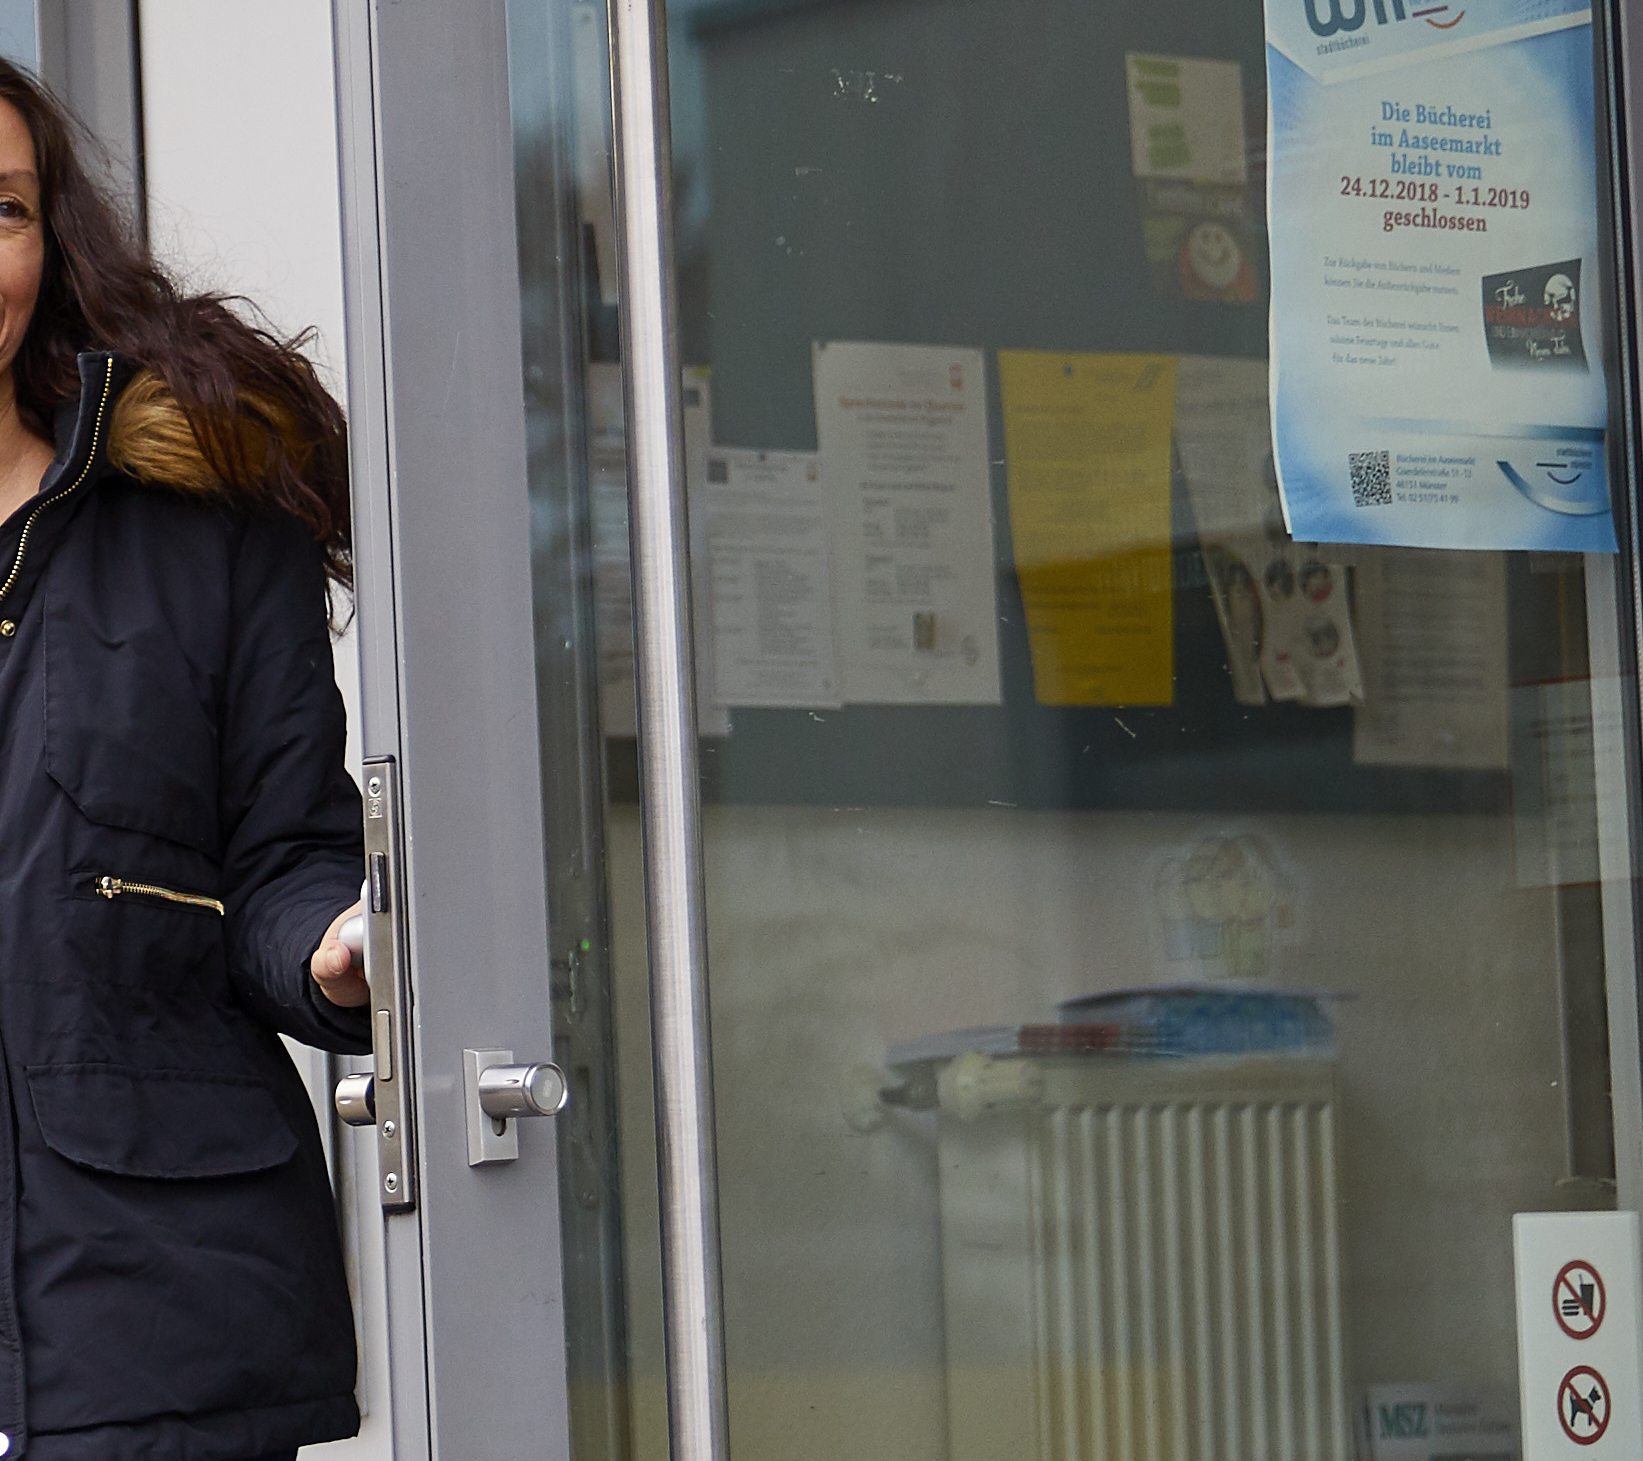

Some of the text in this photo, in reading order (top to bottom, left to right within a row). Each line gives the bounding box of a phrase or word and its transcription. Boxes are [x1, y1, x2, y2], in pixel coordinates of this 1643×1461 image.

[1381, 101, 1491, 129] Die Bücherei
[1371, 126, 1502, 156] im Aaseemarkt
[1391, 153, 1482, 180] bleibt vom
[1340, 176, 1438, 202] 24.12.2018
[1455, 186, 1530, 209] 1.1.2019
[1382, 208, 1487, 232] geschlossen
